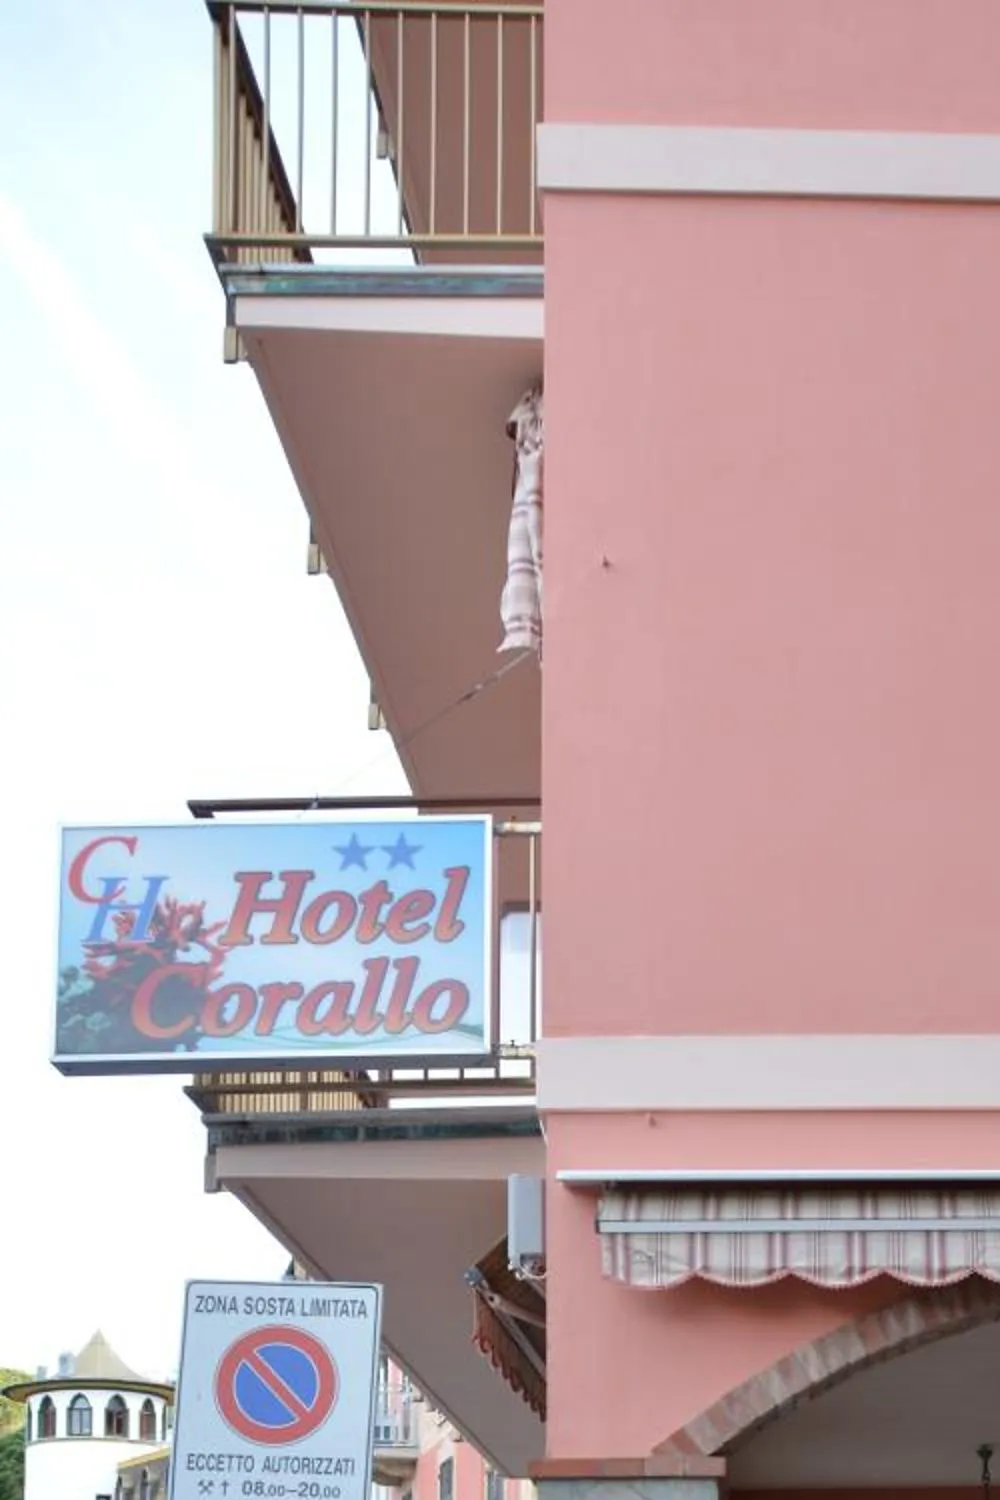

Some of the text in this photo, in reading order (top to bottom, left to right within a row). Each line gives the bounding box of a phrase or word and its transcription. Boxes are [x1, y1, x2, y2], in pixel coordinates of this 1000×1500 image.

[220, 865, 471, 945] Hotel
[130, 956, 471, 1039] Corallo
[194, 1295, 368, 1319] ZONA SOSTA LIMITATA
[187, 1453, 356, 1476] ECCETTO AUTORIZZATI
